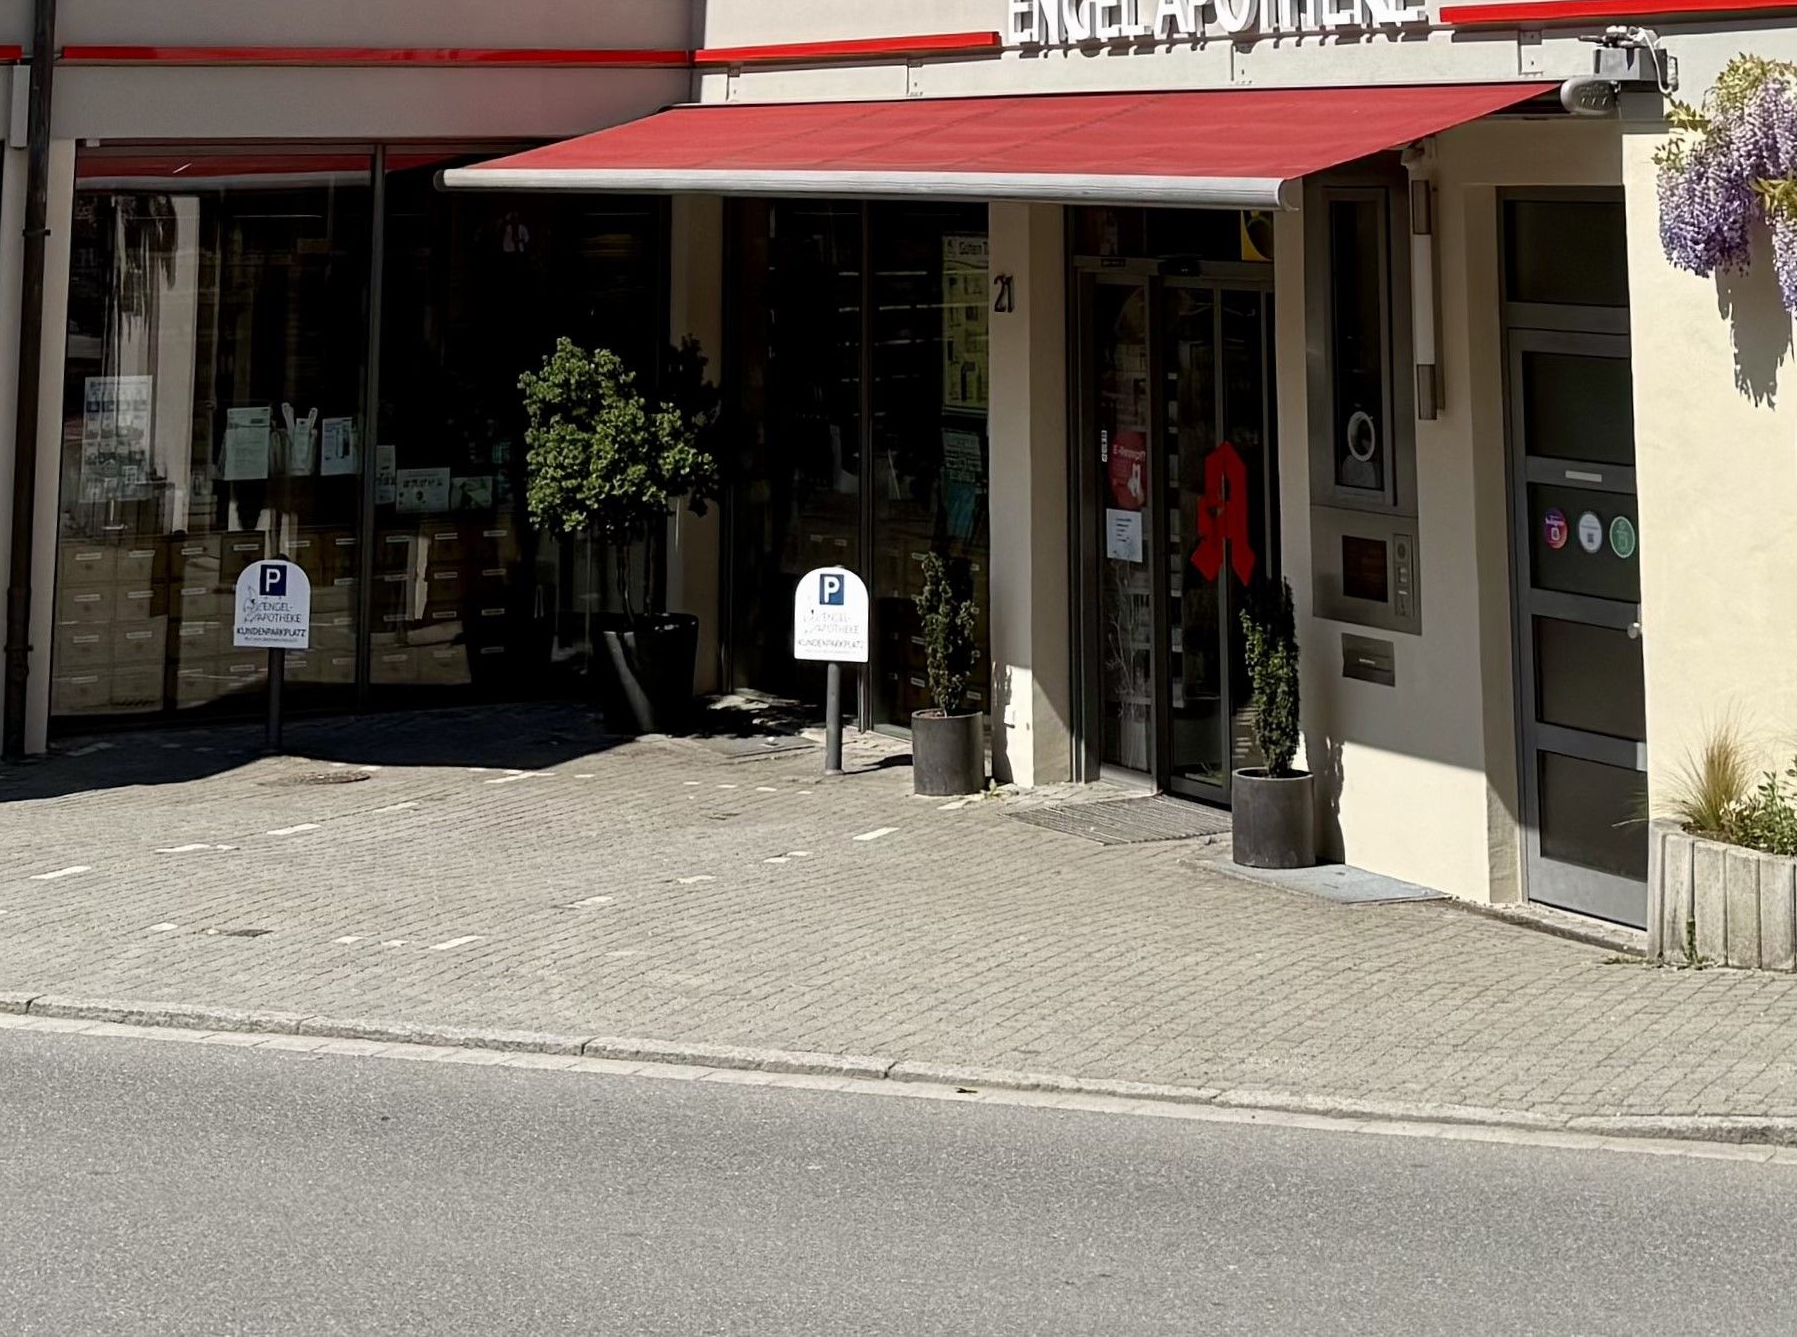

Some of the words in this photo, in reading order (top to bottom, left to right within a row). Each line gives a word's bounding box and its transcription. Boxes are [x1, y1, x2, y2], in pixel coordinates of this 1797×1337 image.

[994, 275, 1015, 313] 21
[265, 568, 281, 592] P
[824, 576, 840, 603] P
